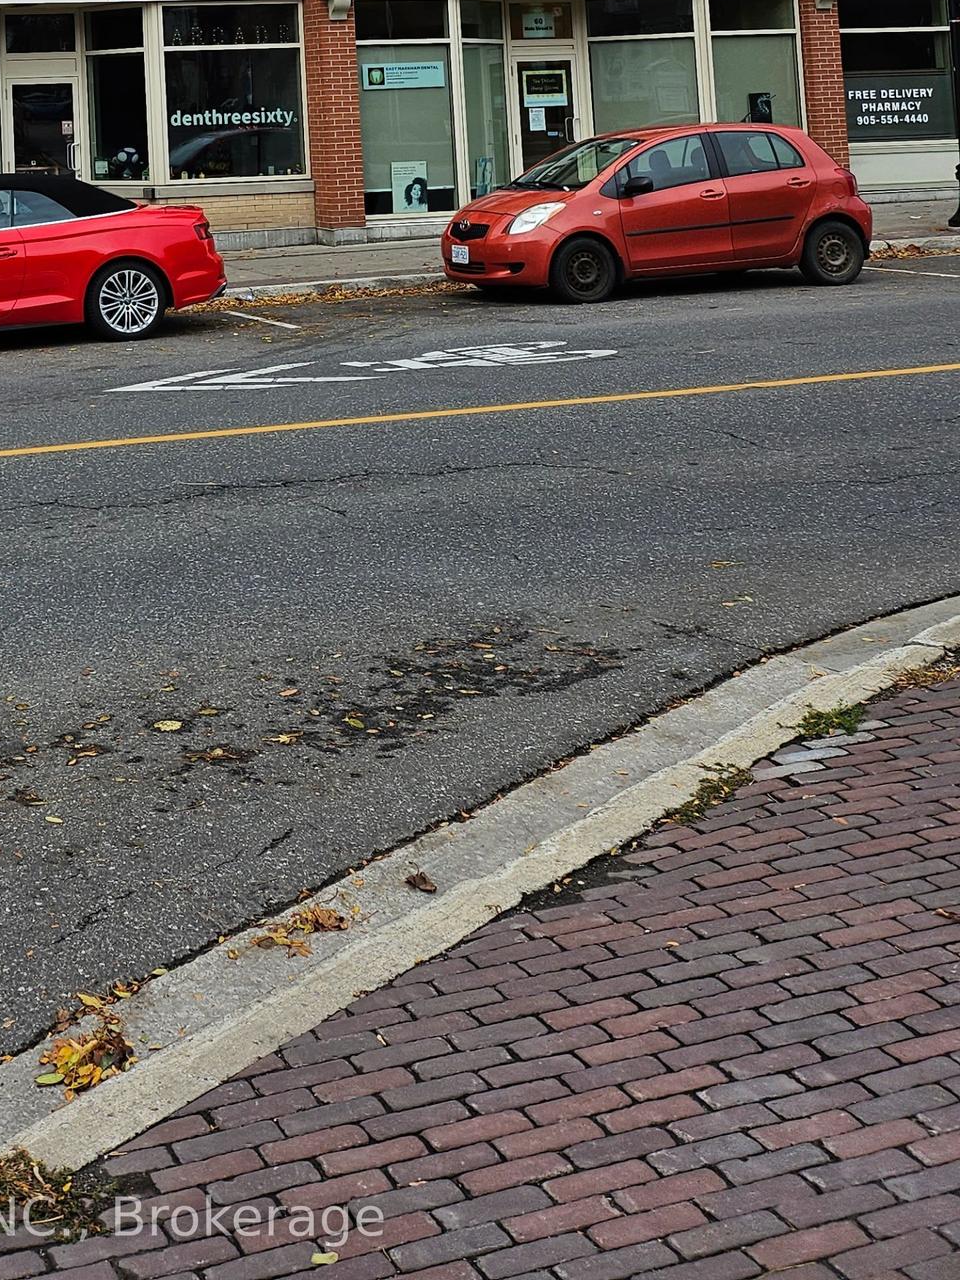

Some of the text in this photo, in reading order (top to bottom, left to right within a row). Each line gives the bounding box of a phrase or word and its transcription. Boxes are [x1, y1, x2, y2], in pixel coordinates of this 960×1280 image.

[848, 88, 933, 100] FREE DELIVERY
[862, 101, 922, 112] PHARMACY
[170, 107, 298, 126] denthreesixty.
[856, 114, 929, 125] 905-554-4440
